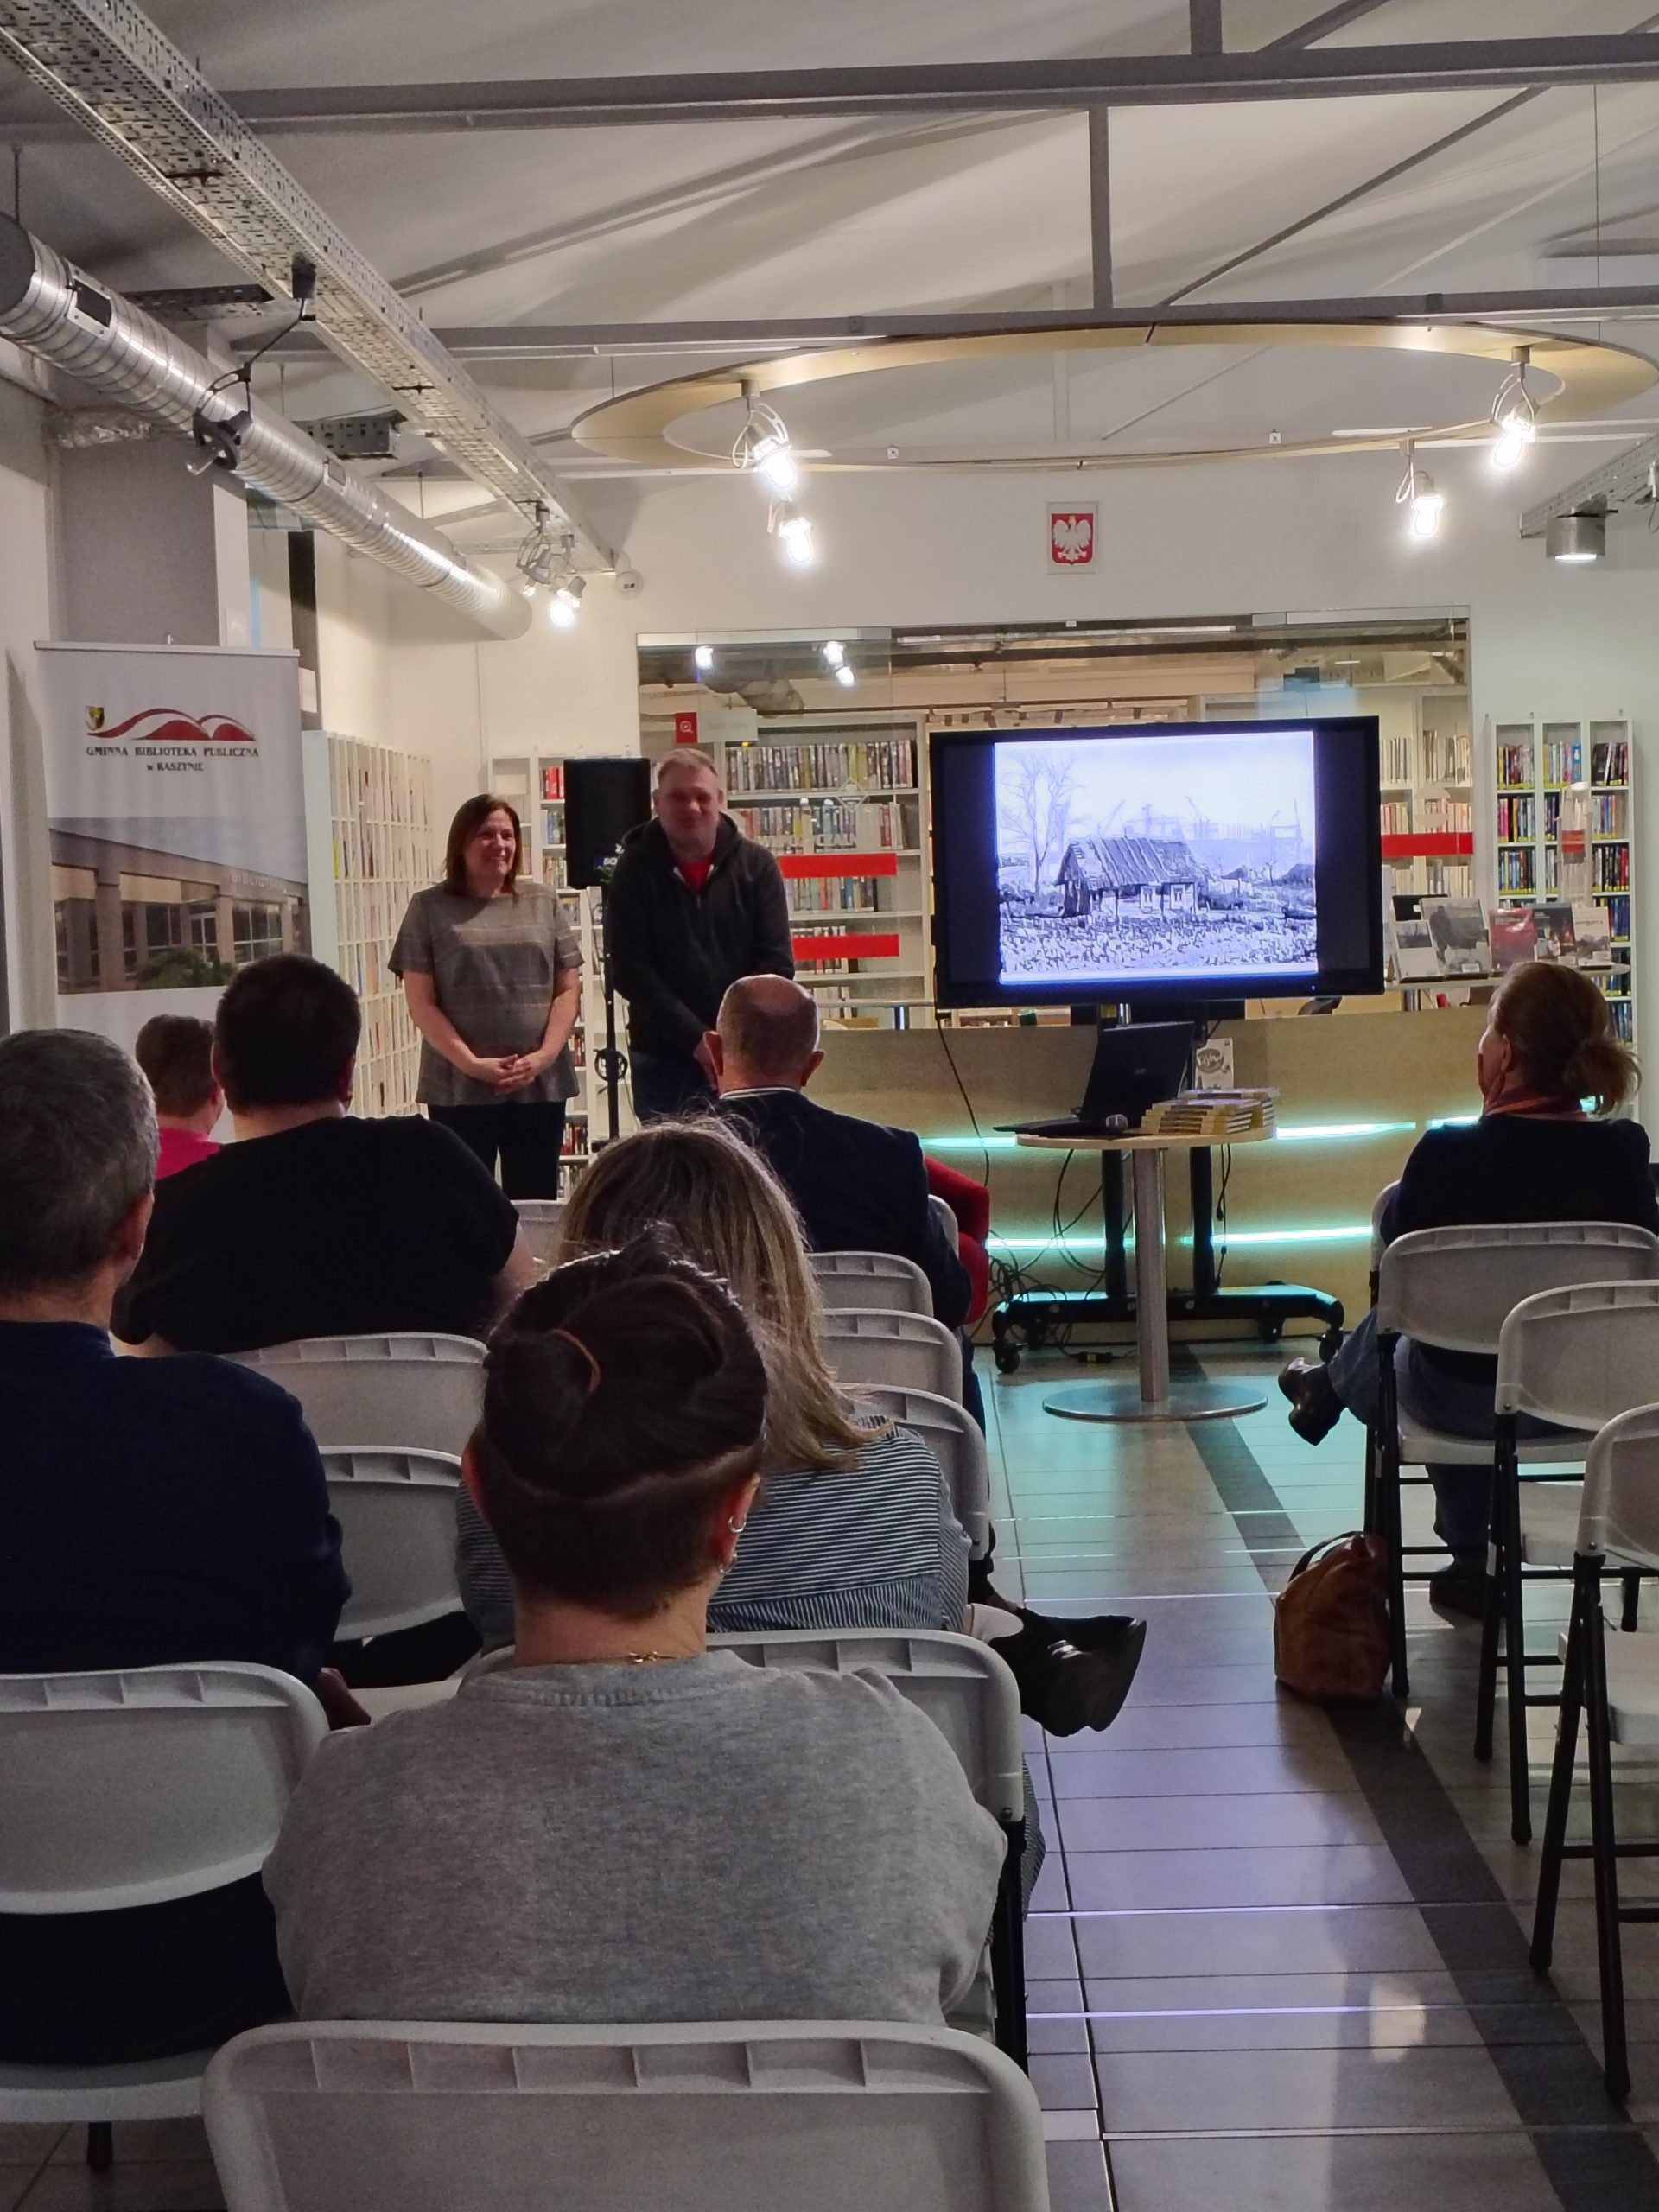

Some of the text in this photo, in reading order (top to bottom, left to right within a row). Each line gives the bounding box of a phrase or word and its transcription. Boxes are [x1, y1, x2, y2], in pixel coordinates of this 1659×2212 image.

[86, 746, 259, 757] GMINNA BIBLIOTEKA PUBLICZNA
[156, 762, 205, 772] RASZYNIE
